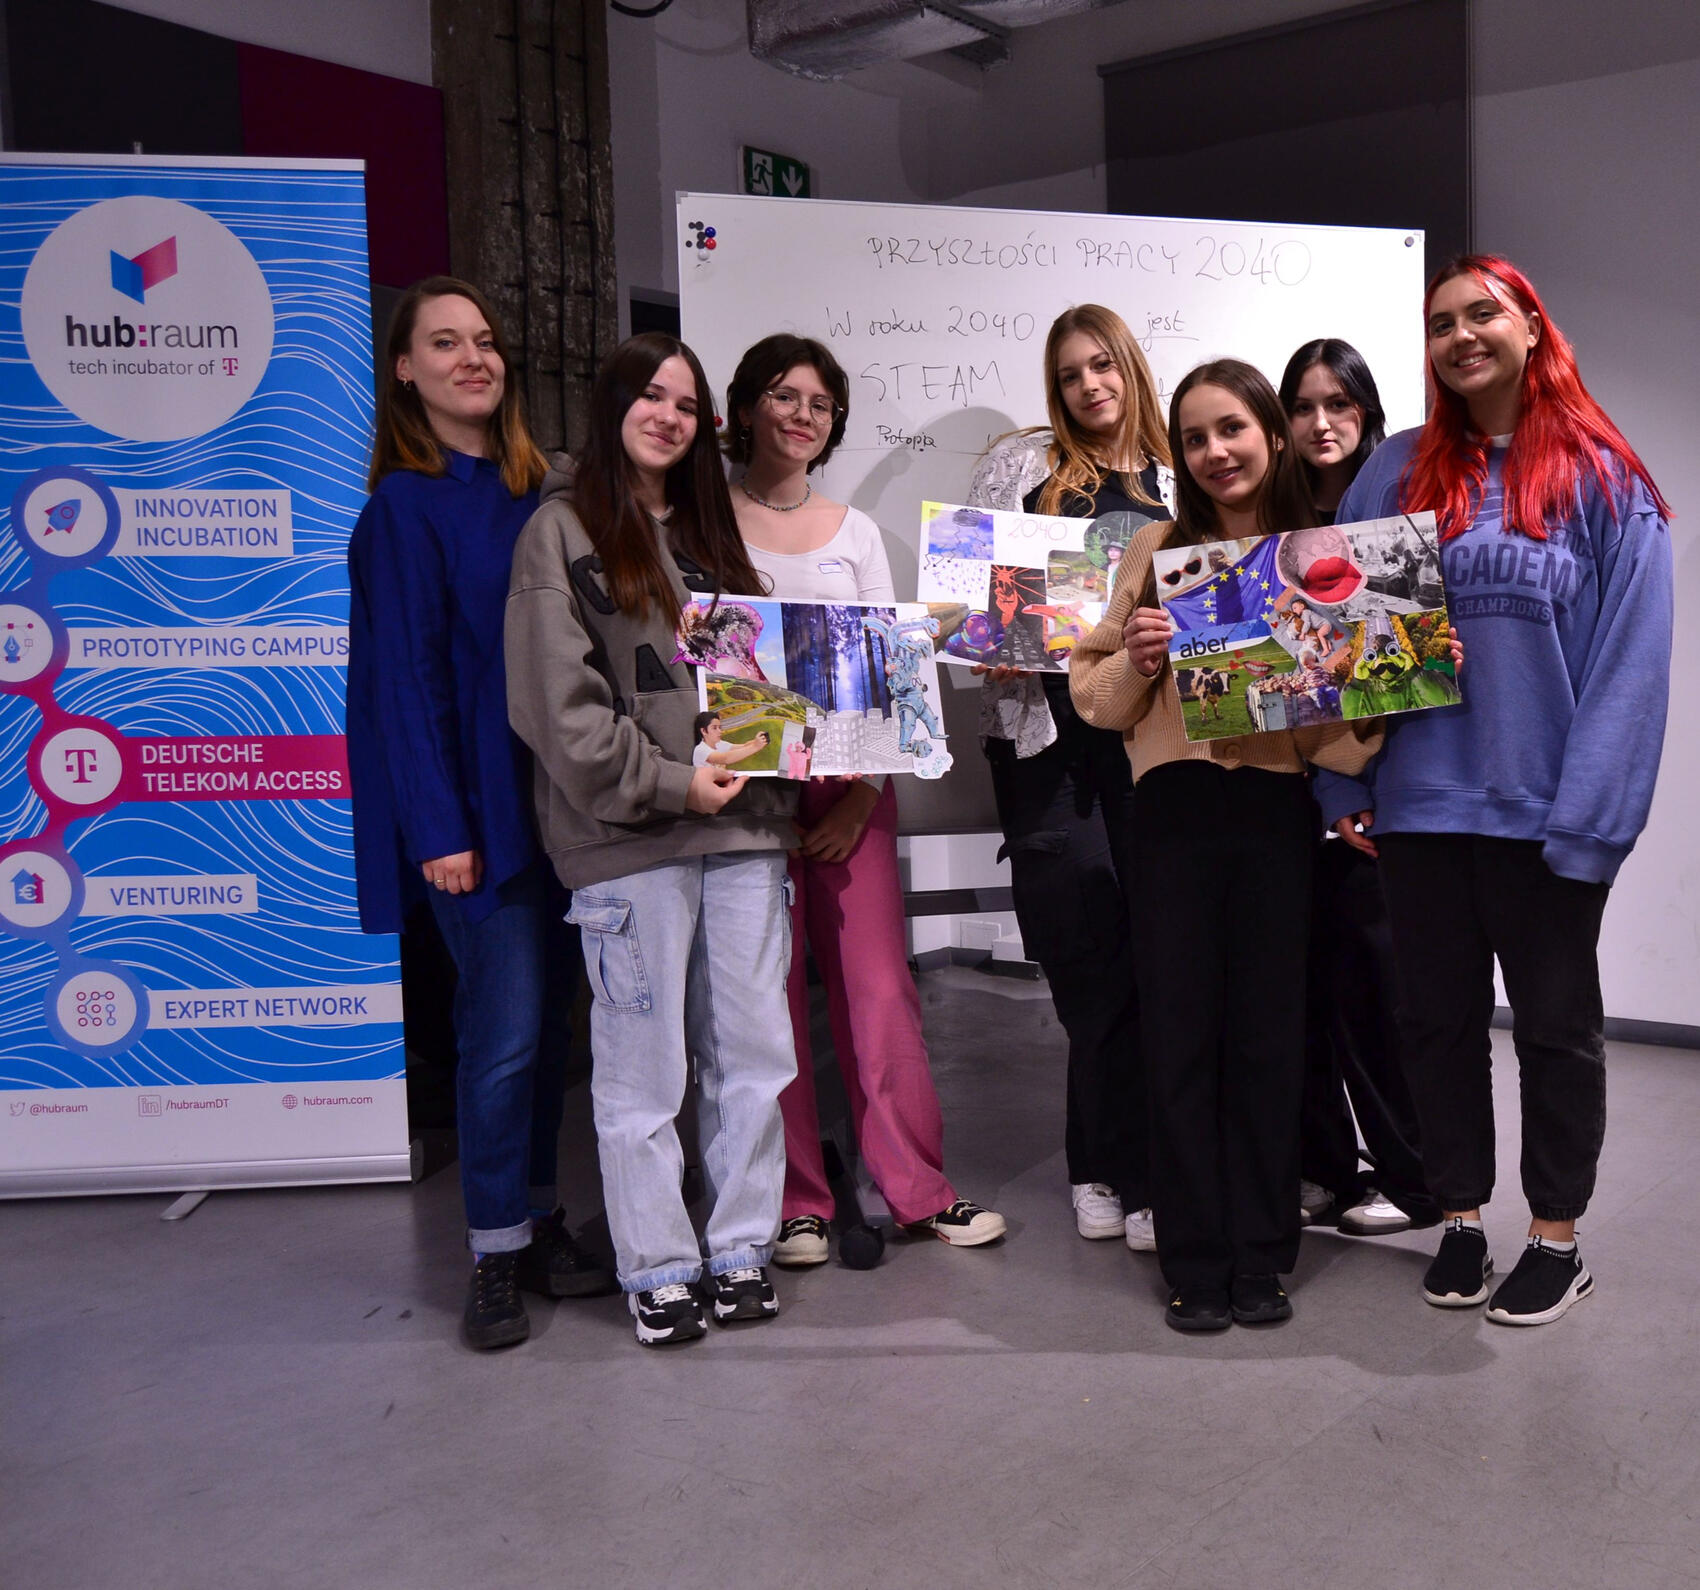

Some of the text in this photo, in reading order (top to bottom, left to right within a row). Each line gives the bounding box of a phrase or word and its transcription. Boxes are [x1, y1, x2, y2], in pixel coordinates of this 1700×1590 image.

[1076, 237, 1178, 275] PRACY
[1195, 235, 1312, 287] 2040
[65, 315, 239, 349] hub:raum
[826, 305, 1035, 341] W roku 2040
[1142, 310, 1185, 352] jest
[68, 360, 108, 376] tech
[112, 359, 194, 376] incubator
[197, 359, 216, 376] of
[860, 360, 1006, 407] STEAM
[135, 498, 278, 519] INNOVATION
[136, 526, 279, 547] INCUBATION
[1007, 518, 1068, 541] 2040
[1449, 542, 1594, 607] CADEMY
[1455, 599, 1551, 621] CHAMPIONS
[83, 636, 349, 658] PROTOTYPING CAMPUS
[142, 743, 264, 765] DEUTSCHE
[142, 770, 342, 792] TELEKOM ACCESS
[110, 885, 243, 906] VENTURING
[165, 996, 367, 1020] EXPERT NETWORK
[29, 1102, 88, 1116] @hubraum
[166, 1097, 230, 1111] /hubraumDT
[303, 1093, 373, 1106] hubraum.com
